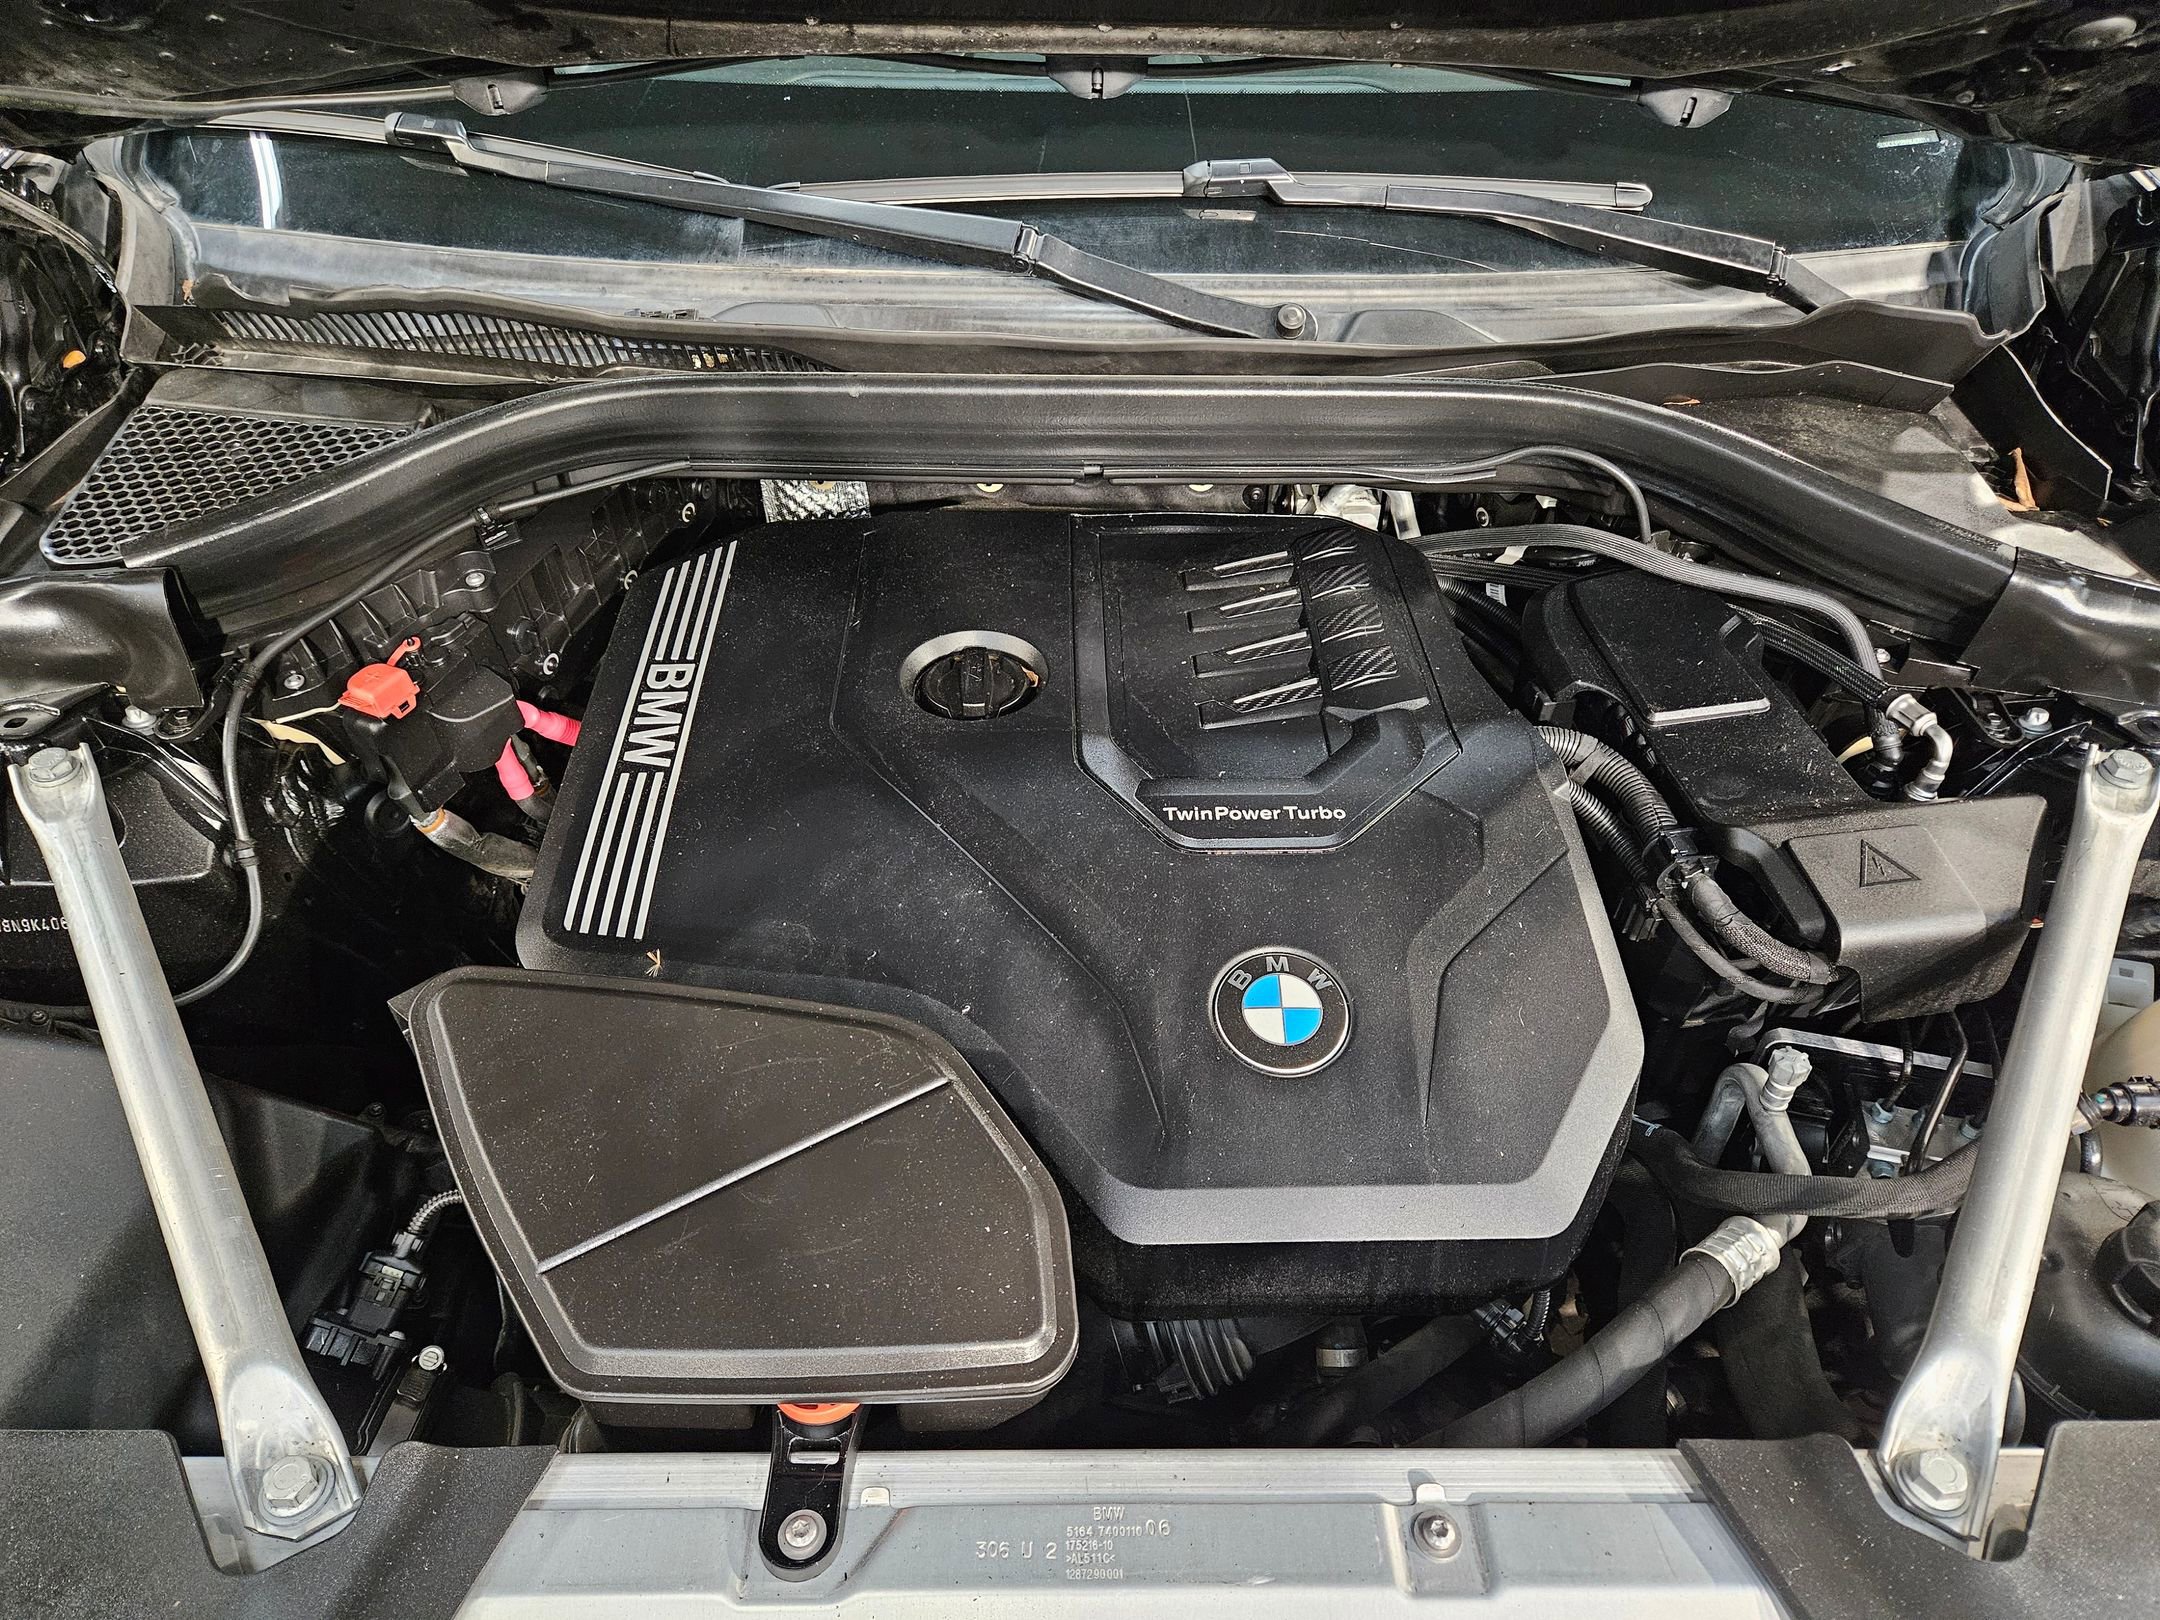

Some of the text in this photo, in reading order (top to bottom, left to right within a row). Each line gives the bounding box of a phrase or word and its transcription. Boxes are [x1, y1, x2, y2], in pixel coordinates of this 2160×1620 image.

[622, 663, 696, 768] BMW
[1283, 805, 1347, 820] Turbo
[0, 916, 69, 933] 8N9K406
[1227, 956, 1334, 991] BMW
[1093, 1506, 1126, 1521] BMW
[1066, 1526, 1094, 1537] 5164
[1098, 1526, 1143, 1537] 7400110
[975, 1540, 1010, 1559] 306
[1046, 1541, 1057, 1560] 2
[1065, 1540, 1114, 1551] 175216-10
